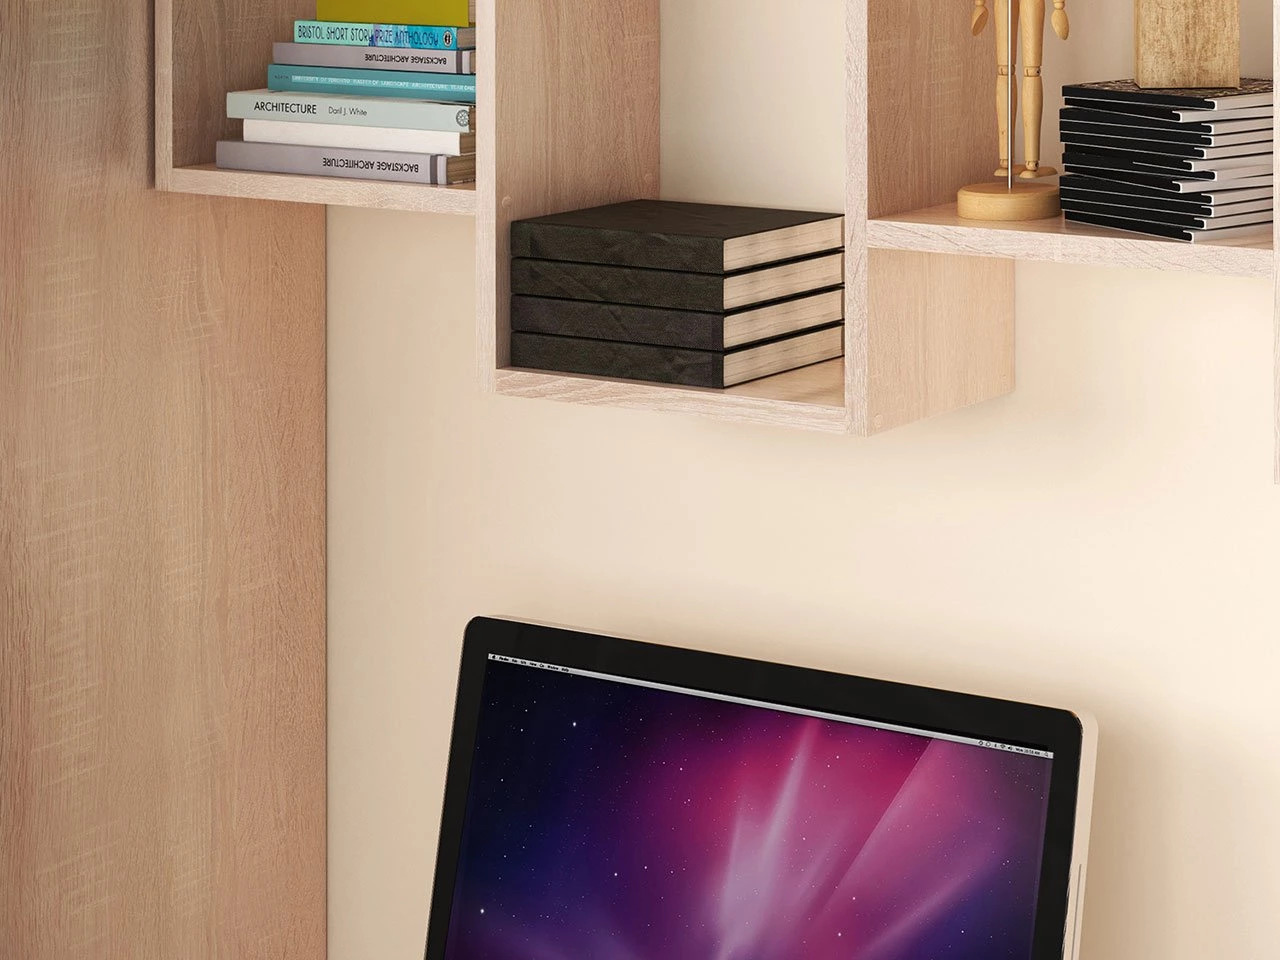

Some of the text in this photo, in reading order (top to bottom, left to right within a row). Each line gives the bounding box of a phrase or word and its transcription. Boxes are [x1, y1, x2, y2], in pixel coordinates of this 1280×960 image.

[298, 25, 439, 46] BRISTOL SHORT STORY PRIZE ANTHOLOGY
[364, 53, 447, 65] BACKSTAGE ARCHITECTURE
[254, 101, 317, 114] ARCHITECTURE
[349, 107, 368, 117] White
[322, 157, 419, 173] BACKSTAGE ARCHITECTURE
